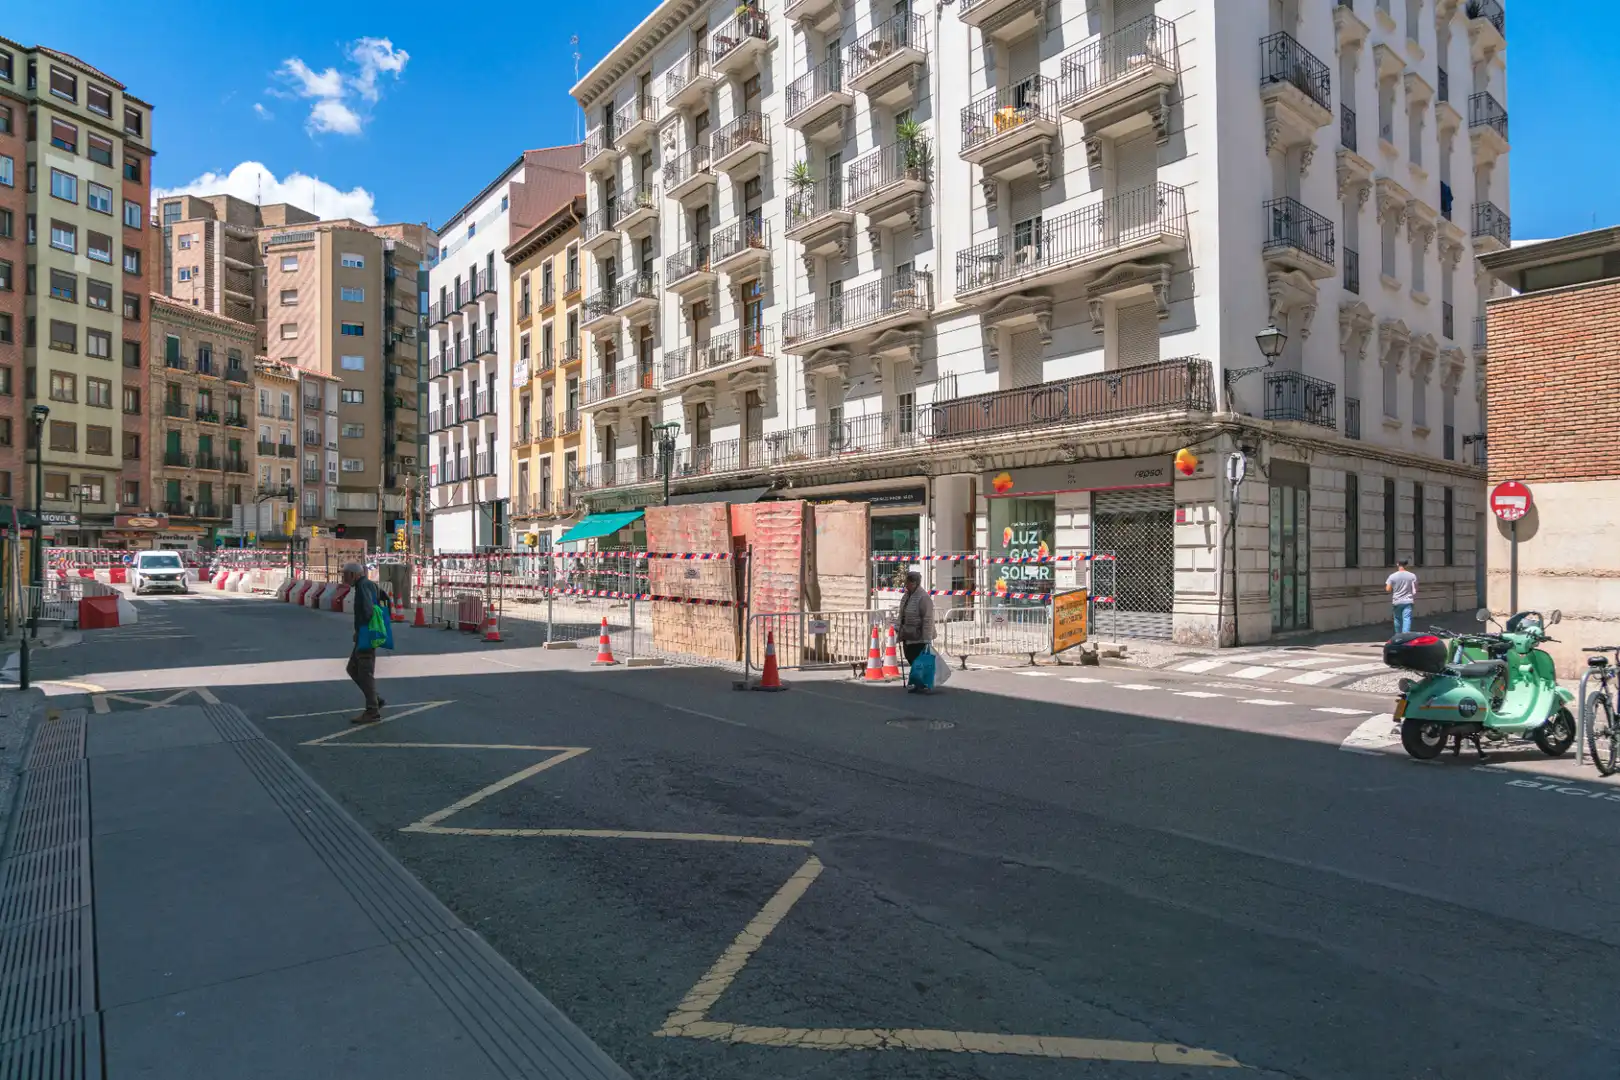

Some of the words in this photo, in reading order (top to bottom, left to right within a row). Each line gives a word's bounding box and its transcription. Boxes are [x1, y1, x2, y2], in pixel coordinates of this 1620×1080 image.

[1134, 467, 1164, 479] repsol
[1010, 530, 1038, 545] LUZ
[1009, 548, 1039, 563] GAS
